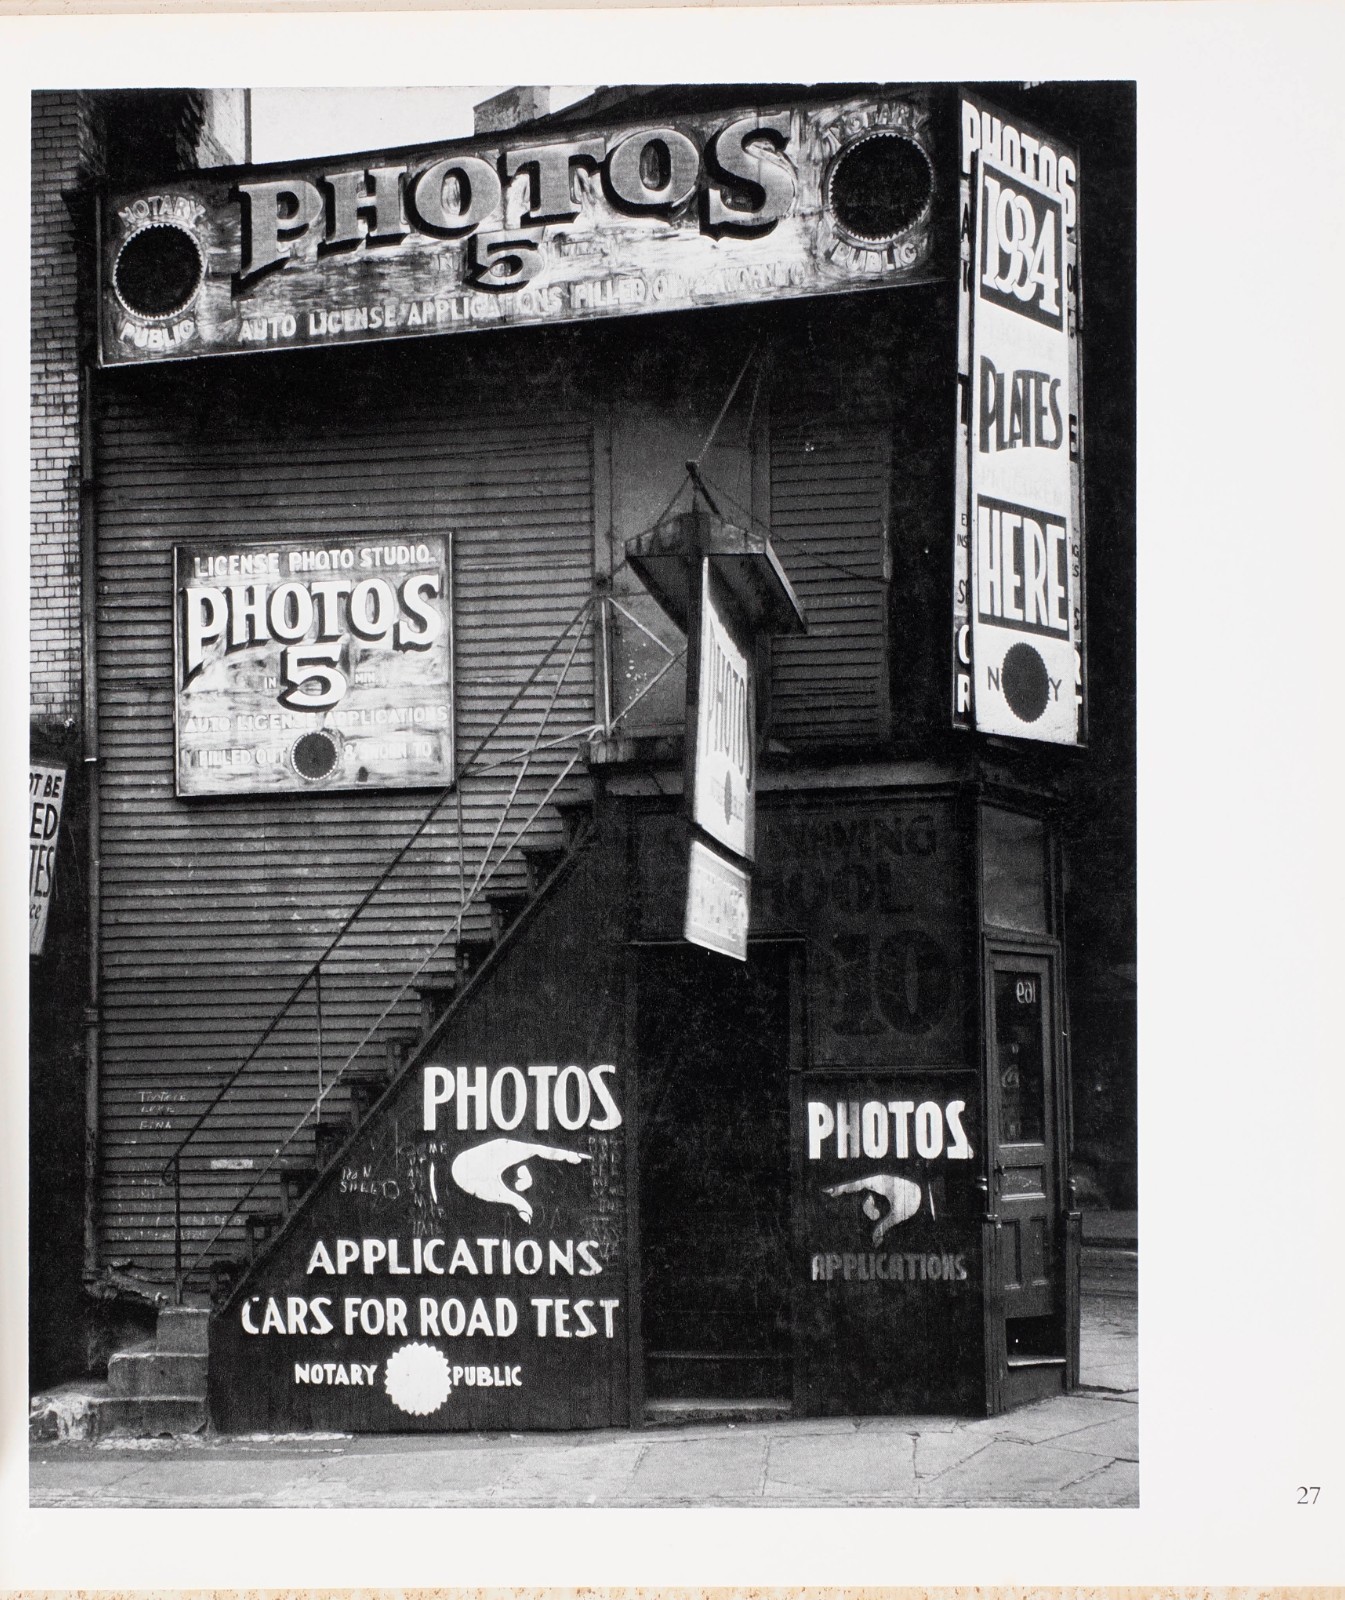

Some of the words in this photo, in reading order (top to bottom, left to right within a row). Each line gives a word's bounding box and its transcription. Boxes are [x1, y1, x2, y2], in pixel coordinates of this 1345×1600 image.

[962, 99, 1077, 229] PHOTOS
[117, 194, 205, 227] NOTARY
[232, 110, 798, 298] PHOTOS
[463, 229, 545, 294] 5
[830, 238, 918, 272] PUBLIC
[982, 174, 1061, 317] 1934
[119, 319, 197, 351] PUBLIC
[238, 315, 297, 341] AUTO
[308, 303, 399, 337] LICENSE
[980, 355, 1062, 453] PLATES
[194, 554, 280, 578] LICENSE
[288, 549, 355, 571] PHOTO
[360, 545, 430, 568] STUDIO
[978, 504, 1069, 632] HERE
[182, 574, 442, 692] PHOTOS
[263, 676, 277, 690] IN
[277, 644, 348, 713] 5
[987, 666, 1000, 691] N
[1049, 677, 1063, 702] Y
[184, 716, 232, 734] AUTO
[237, 712, 317, 731] LICENSE
[325, 706, 449, 727] APPLICATIONS
[43, 774, 62, 798] BE
[30, 802, 58, 840] ED
[423, 1064, 622, 1131] PHOTOS
[808, 1100, 974, 1159] PHOTOS
[306, 1238, 603, 1276] APPLICATIONS
[812, 1252, 967, 1281] APPLICATIONS
[241, 1297, 334, 1335] CARS
[344, 1298, 408, 1337] FOR
[420, 1298, 518, 1337] ROAD
[531, 1299, 620, 1338] TEST
[294, 1364, 378, 1386] NOTARY
[453, 1366, 523, 1387] PUBLIC
[1296, 1486, 1321, 1504] 27
